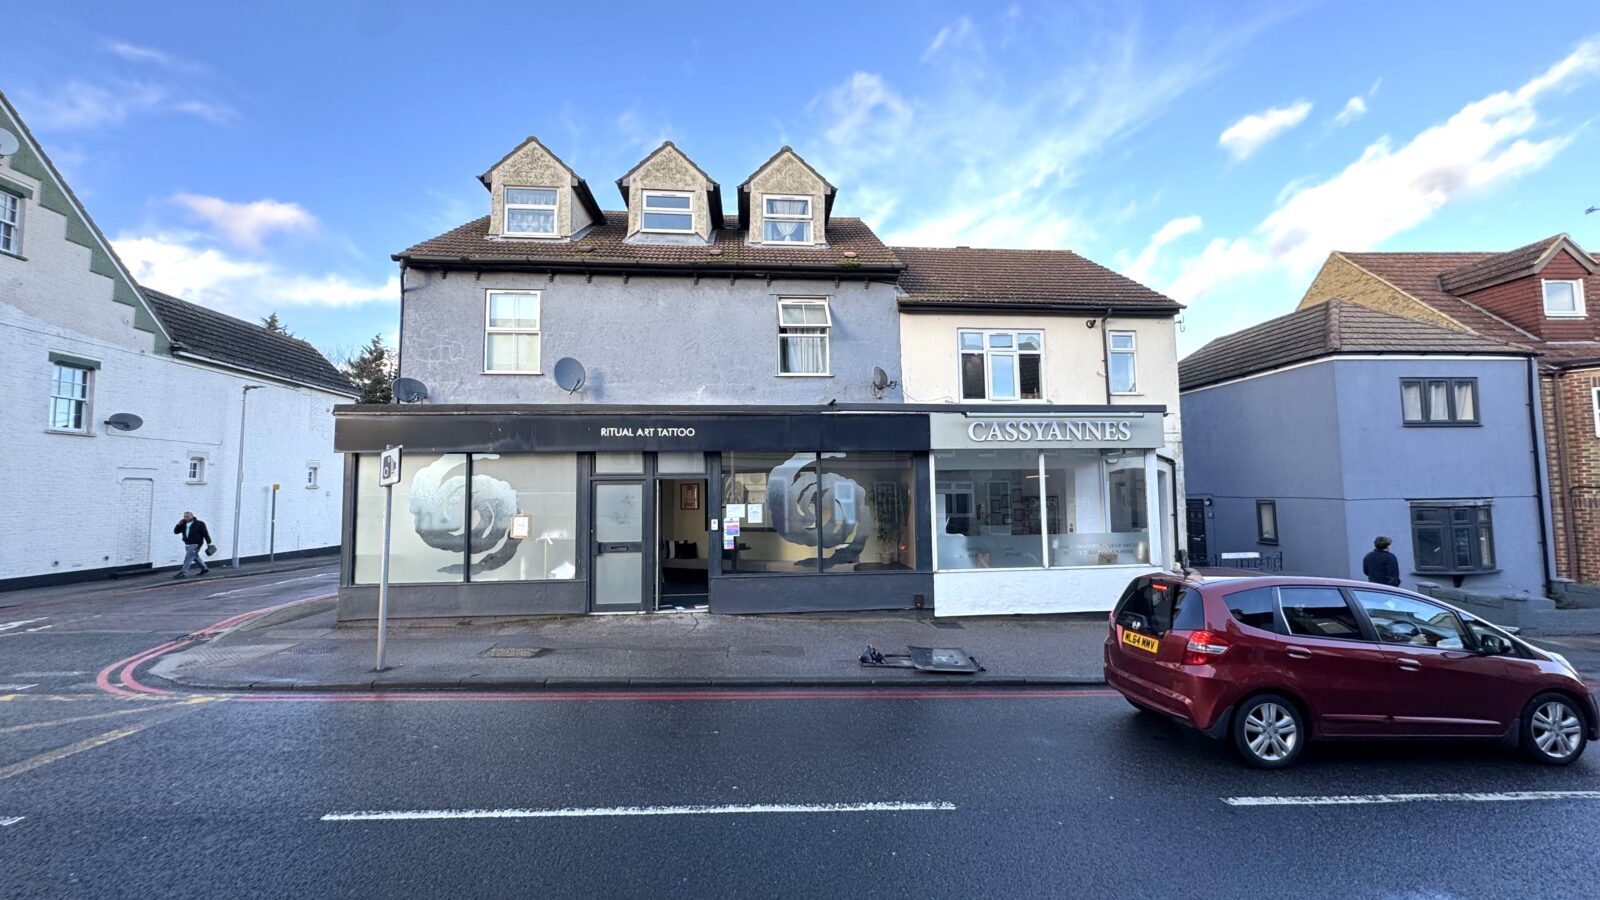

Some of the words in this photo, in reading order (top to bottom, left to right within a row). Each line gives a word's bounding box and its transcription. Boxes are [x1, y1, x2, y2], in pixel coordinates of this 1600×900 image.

[600, 427, 634, 437] RITUAL
[636, 427, 655, 437] ART
[657, 427, 695, 437] TATTOO
[967, 421, 1132, 442] CASSYANNES
